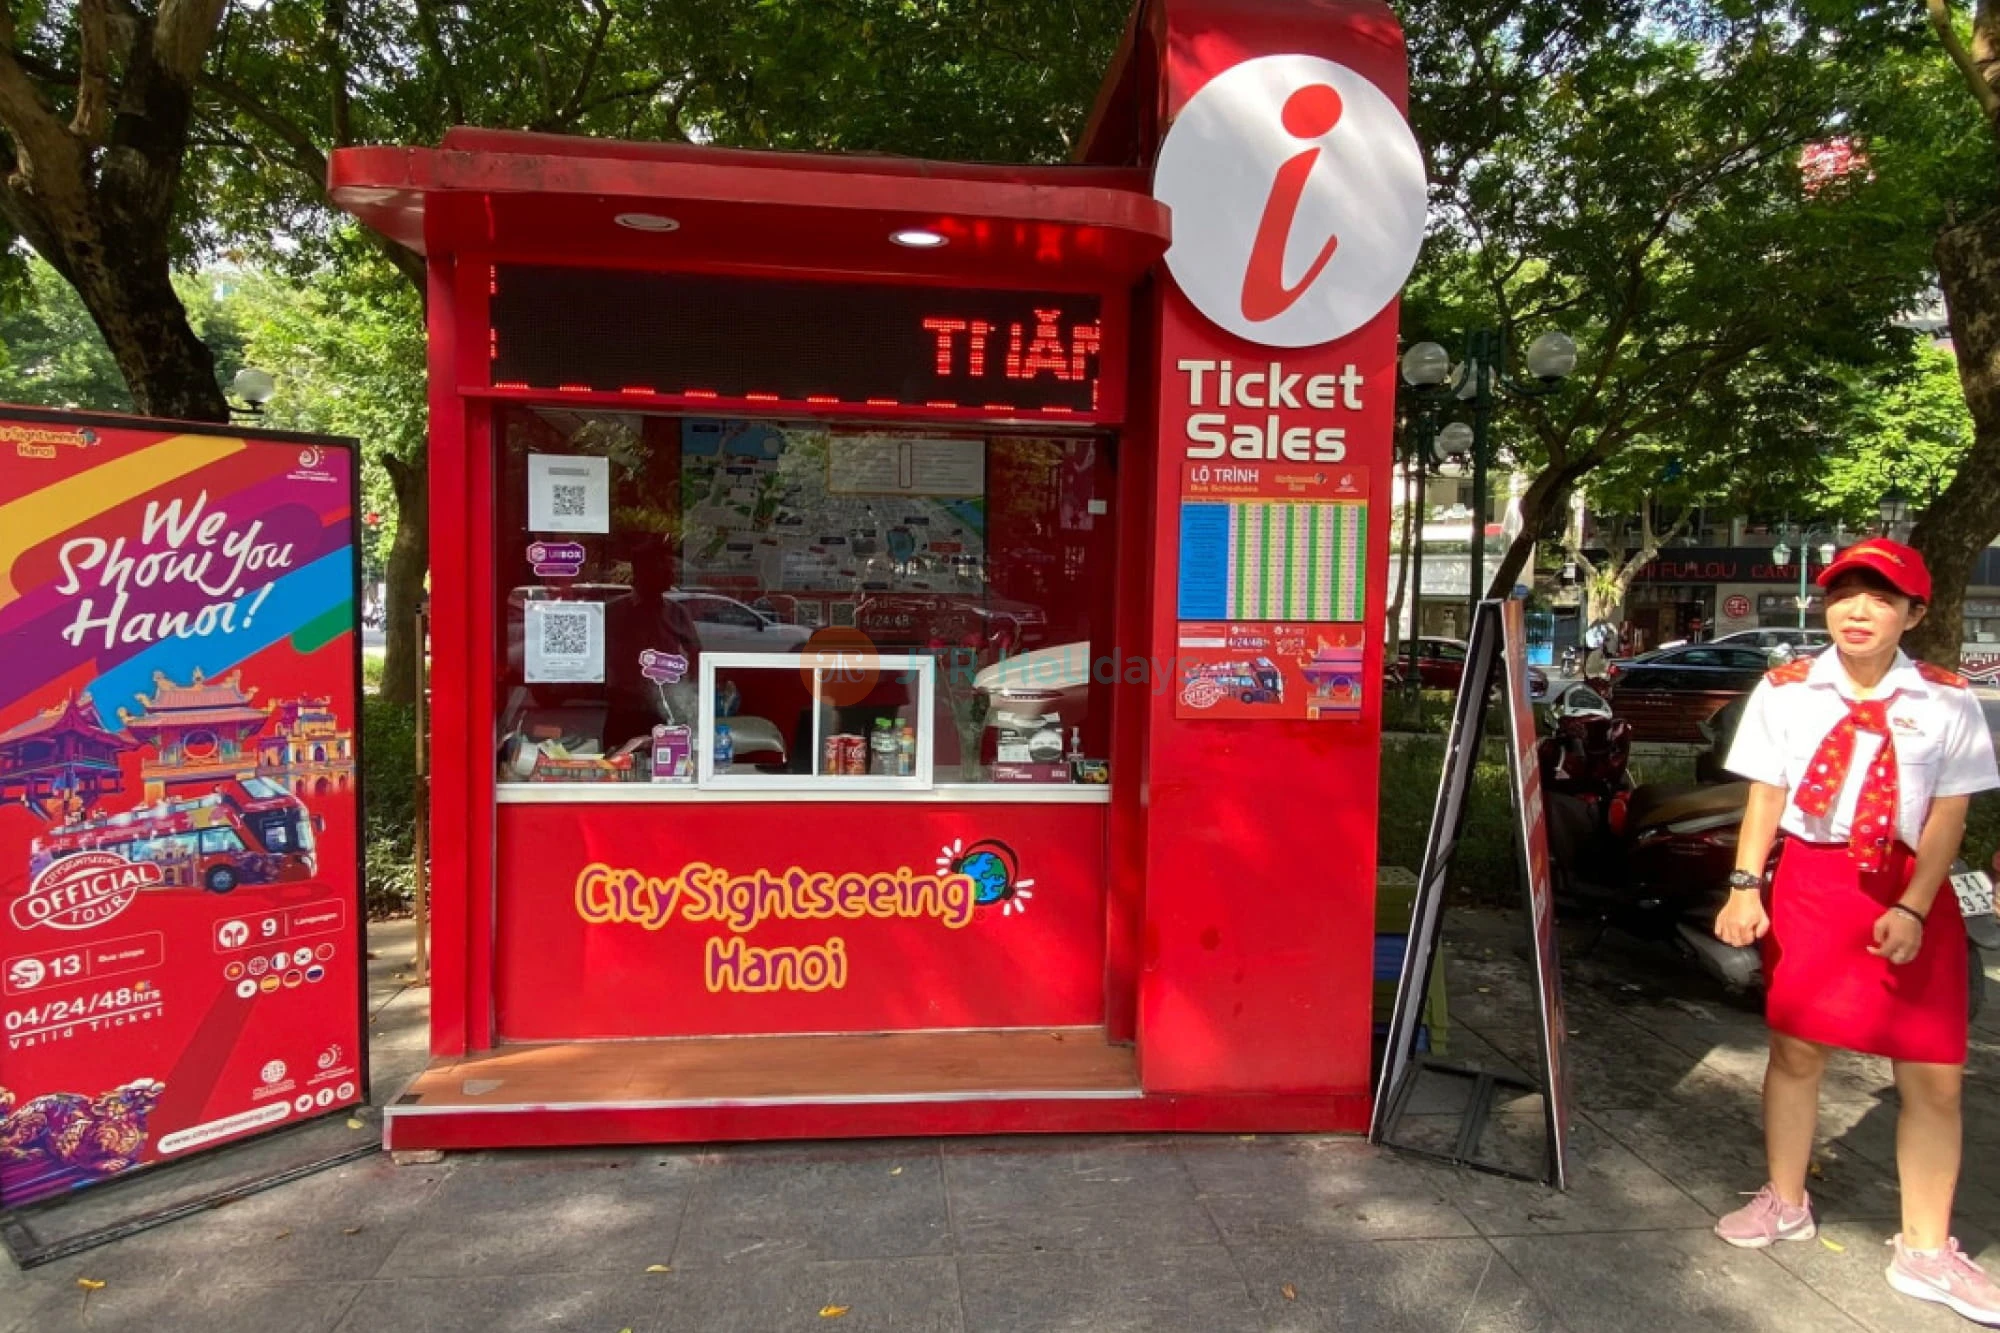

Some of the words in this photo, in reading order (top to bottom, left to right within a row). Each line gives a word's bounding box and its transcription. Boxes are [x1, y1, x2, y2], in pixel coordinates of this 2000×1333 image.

[1177, 359, 1364, 410] Ticket
[1186, 413, 1347, 462] Sales
[1214, 465, 1259, 484] TRÌNH
[142, 489, 228, 549] We
[56, 537, 213, 596] Show
[198, 520, 293, 597] You
[62, 582, 275, 650] Hanoi!
[27, 865, 154, 919] OFFICIAL
[71, 895, 127, 923] TOUR
[575, 862, 975, 933] CitySightseeing
[261, 917, 278, 937] 9
[48, 954, 82, 978] 13
[705, 936, 848, 992] Hanoi
[9, 1028, 74, 1050] Valid
[90, 1007, 164, 1032] Ticket
